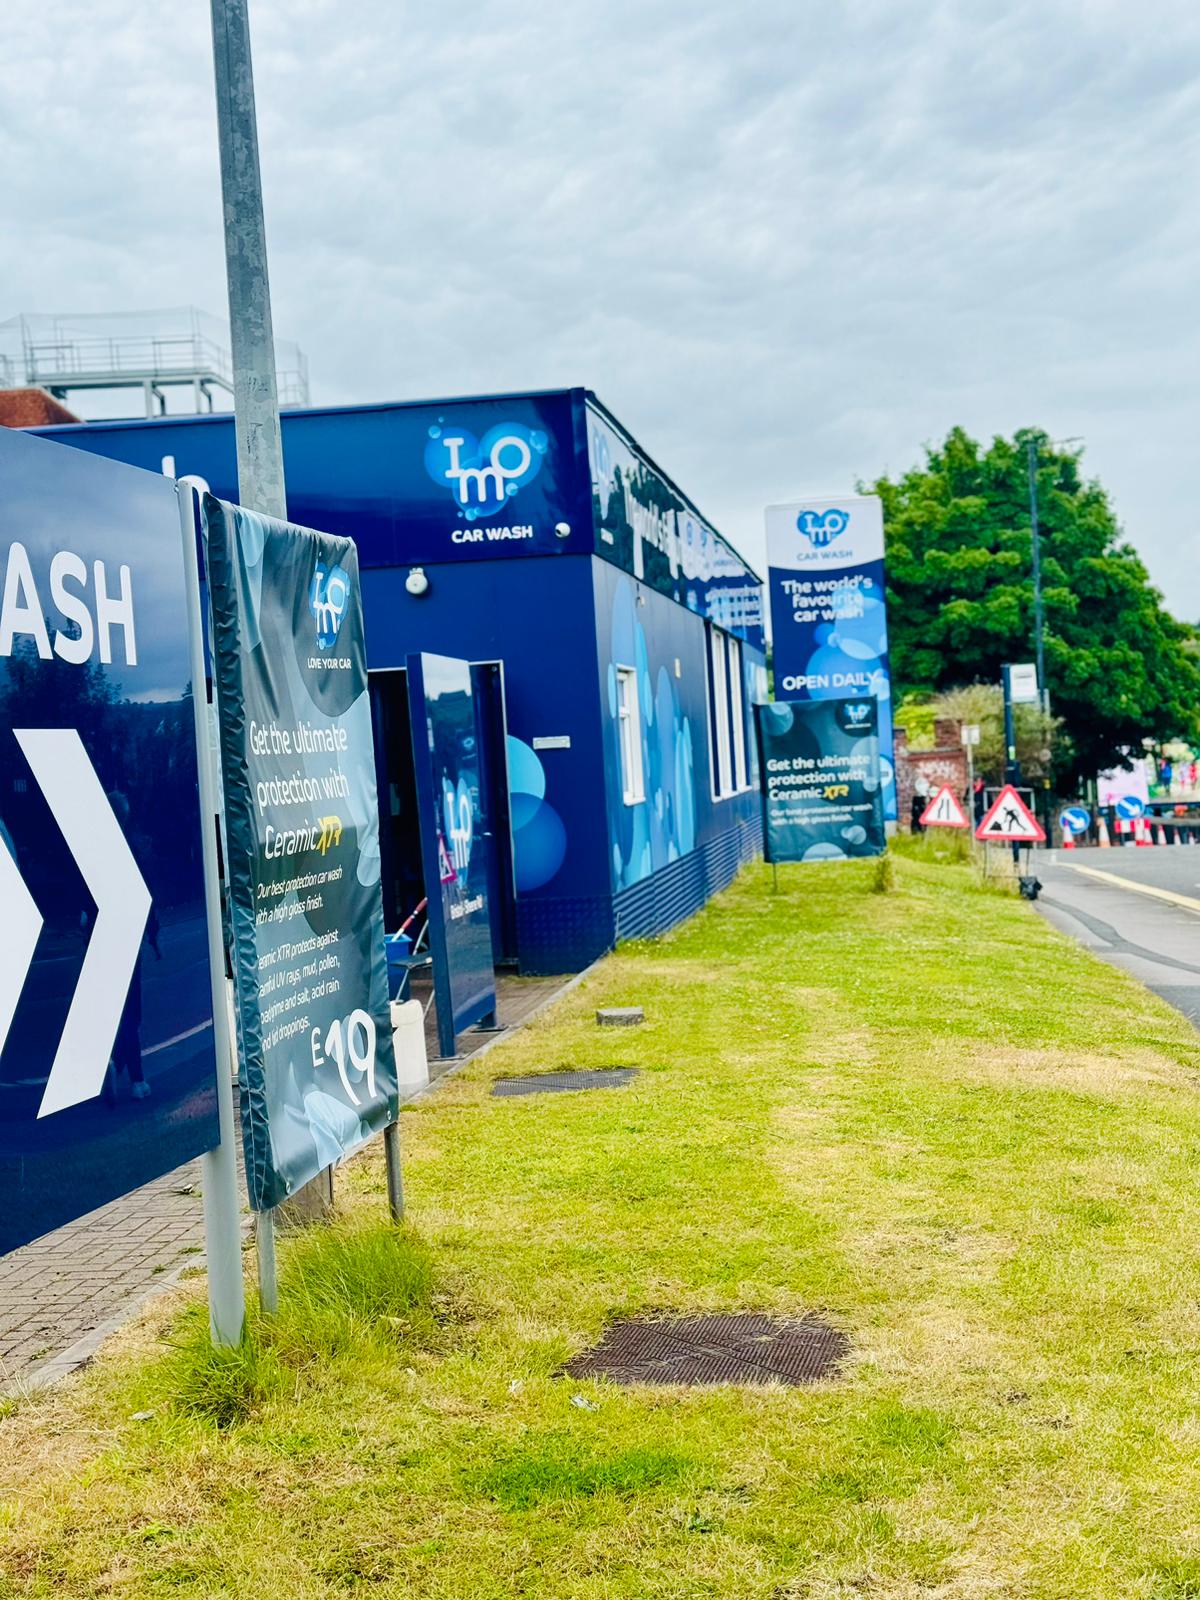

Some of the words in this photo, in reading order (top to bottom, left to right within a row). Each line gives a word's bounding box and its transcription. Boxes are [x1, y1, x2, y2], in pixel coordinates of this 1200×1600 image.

[451, 529, 483, 543] CAR
[486, 525, 533, 541] WASH
[797, 552, 818, 561] CAR
[821, 550, 853, 559] WASH
[781, 579, 812, 595] The
[0, 542, 137, 666] ASH
[792, 589, 864, 608] favourite
[794, 609, 818, 623] car
[822, 604, 864, 620] wash
[307, 658, 321, 669] LOVE
[321, 658, 338, 669] YOUR
[339, 658, 352, 669] CAR
[782, 675, 829, 691] OPEN
[832, 671, 877, 688] DAILY
[250, 721, 270, 755] Get
[271, 723, 290, 754] the
[293, 721, 348, 754] ultimate
[767, 759, 791, 772] Get
[792, 757, 815, 769] the
[817, 754, 871, 768] ultimate
[768, 771, 836, 788] protection
[838, 769, 867, 781] with
[256, 770, 322, 816] protection
[323, 768, 350, 800] with
[769, 786, 823, 801] Ceramic
[264, 818, 319, 860] Ceramic
[271, 880, 285, 896] best
[285, 872, 317, 896] protection
[317, 871, 328, 884] car
[328, 864, 343, 881] wash
[268, 912, 273, 922] a
[274, 903, 288, 923] high
[289, 899, 305, 920] gloss
[306, 893, 324, 912] finish.
[277, 943, 290, 962] XTR
[291, 938, 316, 960] protects
[317, 929, 339, 950] against
[276, 971, 286, 987] UV
[303, 958, 318, 978] mud,
[319, 953, 340, 977] pollen,
[284, 991, 297, 1010] and
[311, 982, 325, 999] acid
[325, 977, 340, 994] rain
[279, 1015, 311, 1040] droppings.
